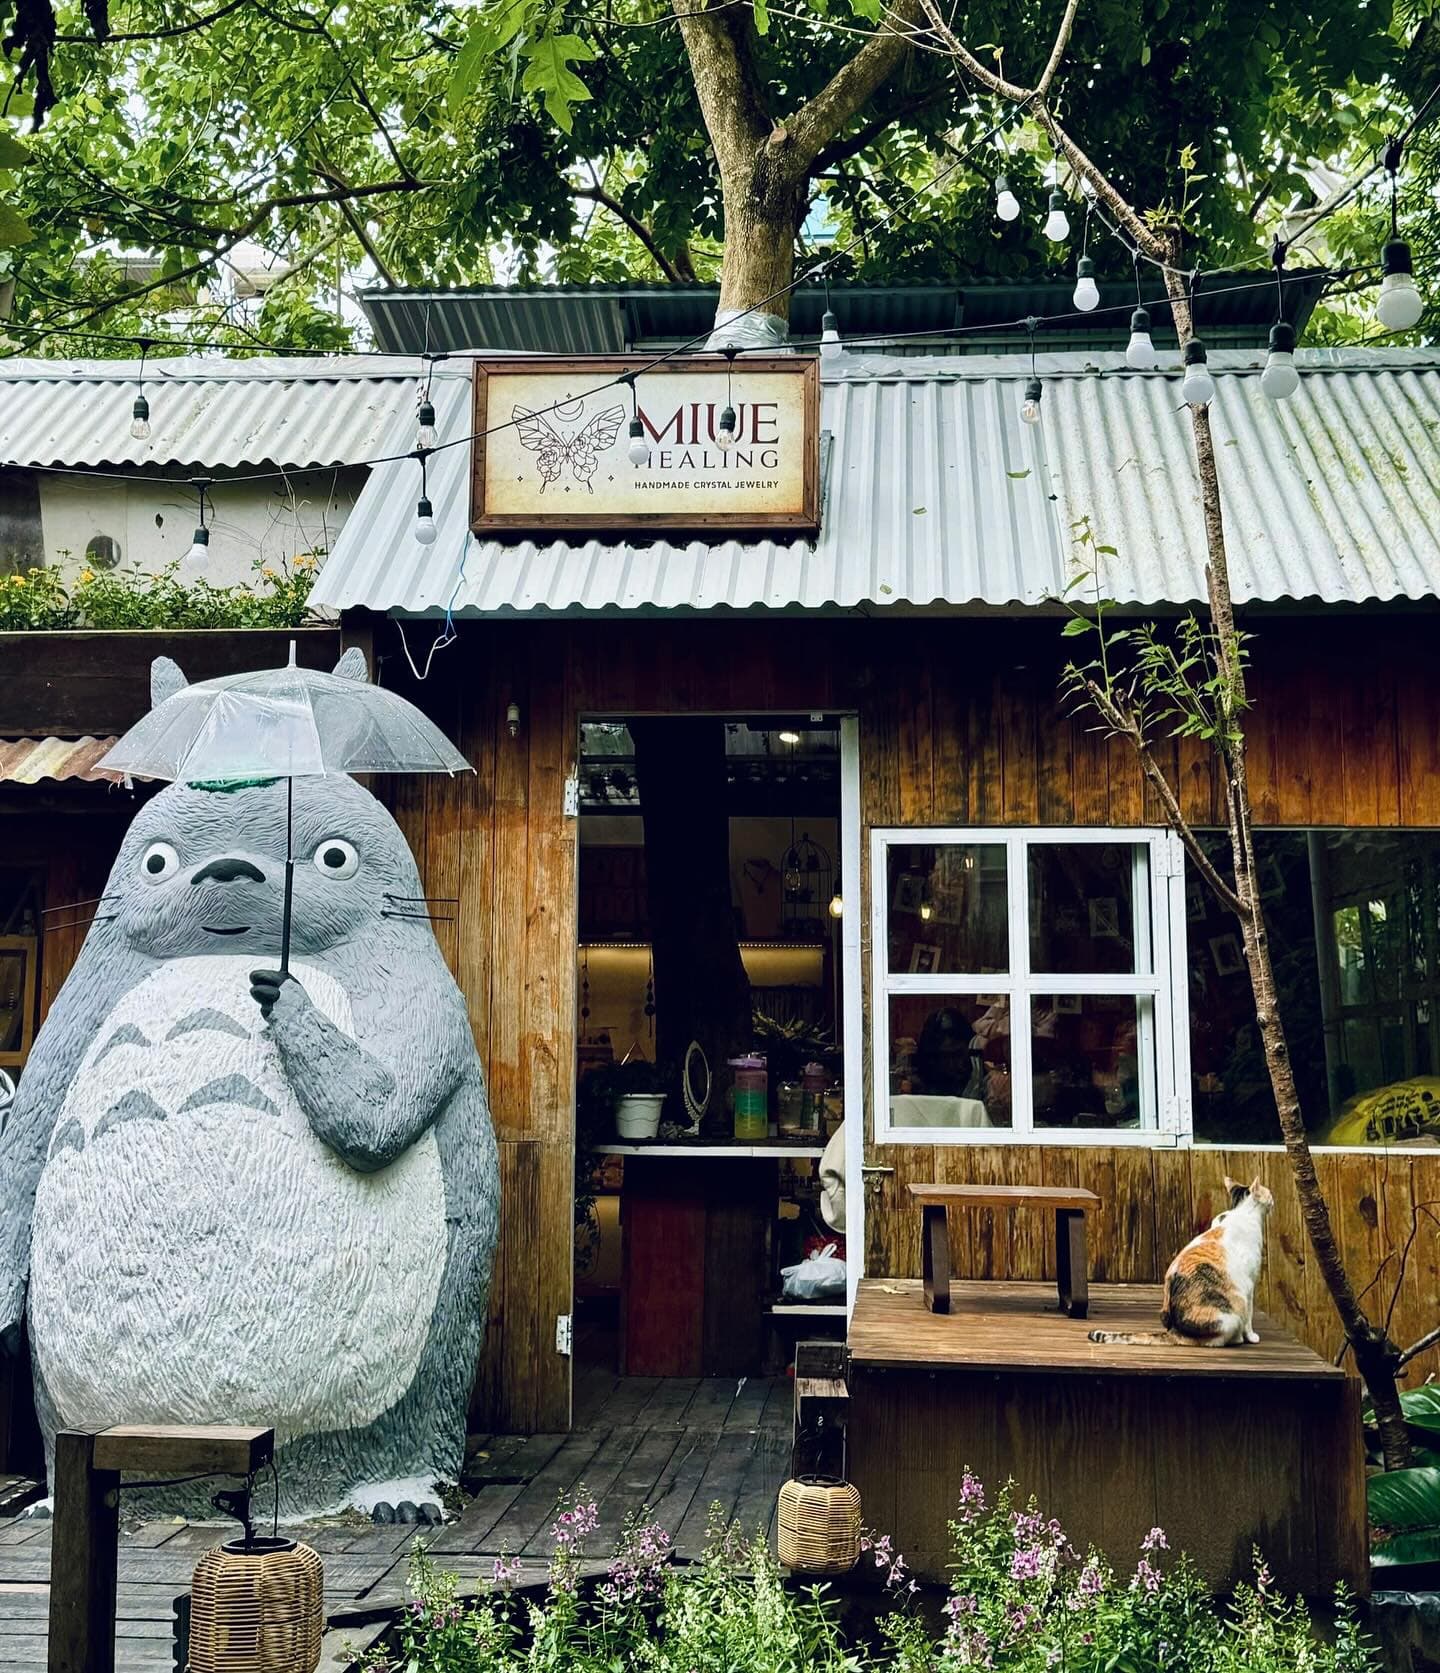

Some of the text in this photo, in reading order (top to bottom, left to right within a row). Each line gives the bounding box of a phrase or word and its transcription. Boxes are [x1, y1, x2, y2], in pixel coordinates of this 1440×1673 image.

[636, 402, 780, 445] MIUE
[634, 480, 779, 489] HANDMADE CRYSTAL JEWELRY
